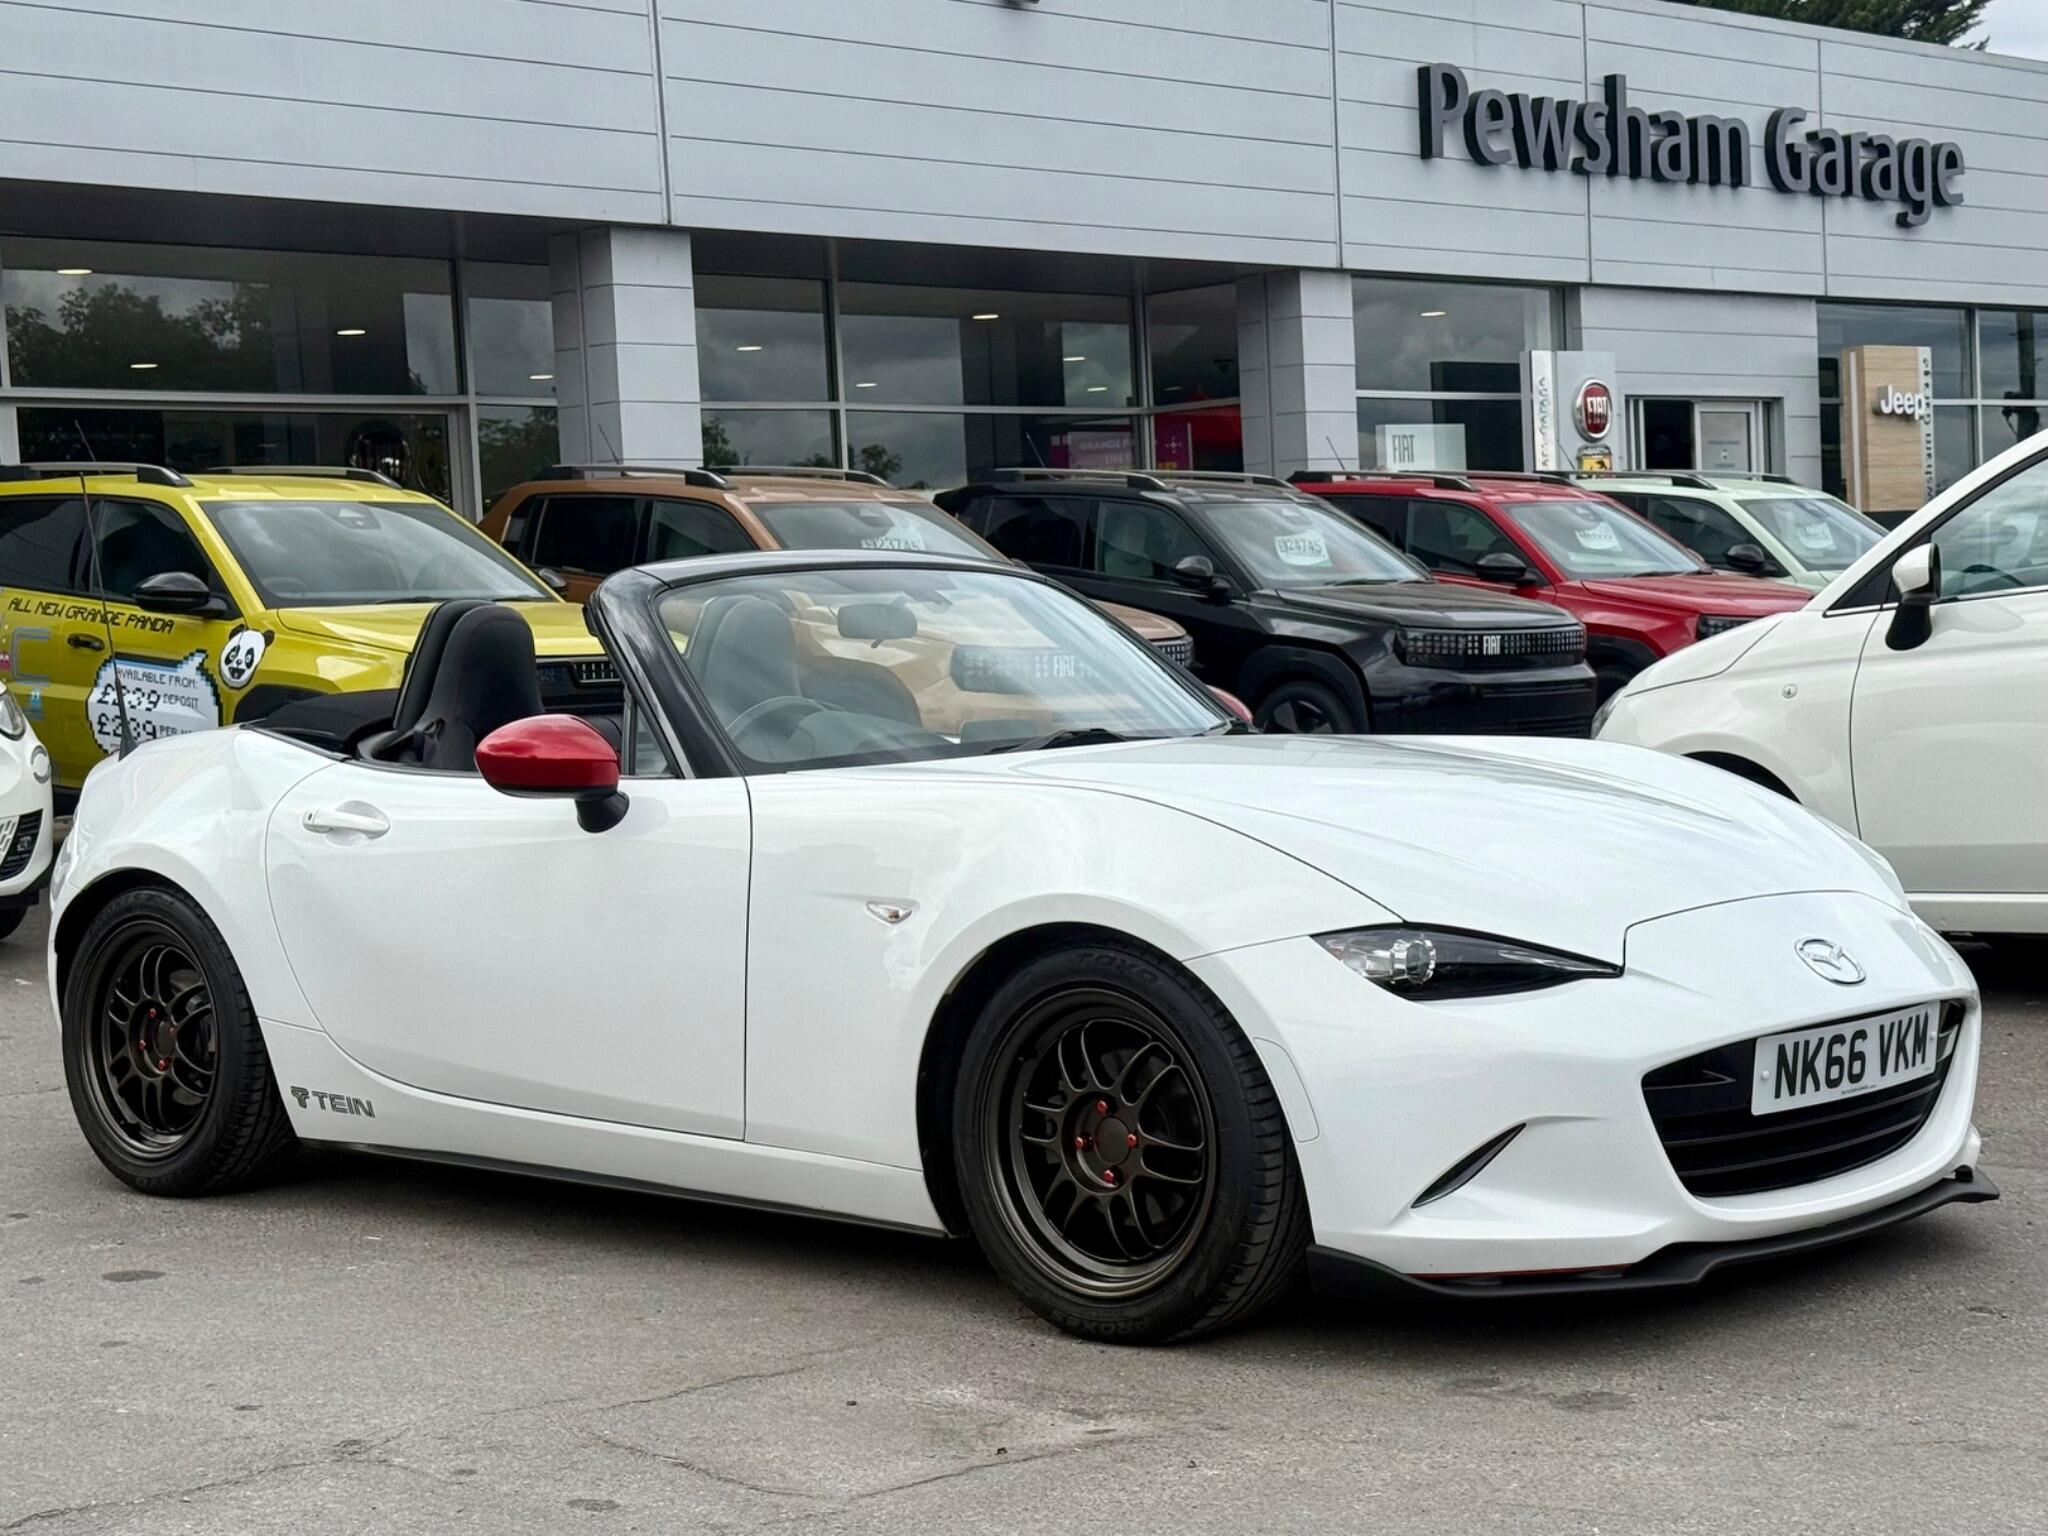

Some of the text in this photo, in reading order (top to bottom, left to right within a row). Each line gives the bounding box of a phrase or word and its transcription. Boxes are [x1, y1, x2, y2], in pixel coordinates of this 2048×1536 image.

[1418, 63, 1964, 228] Pewsham Garage
[1586, 396, 1609, 424] FIAT
[1880, 385, 1927, 421] Jeep
[1391, 434, 1415, 464] FIAT
[8, 597, 175, 634] ALL NEW GRANDE PANDA
[1482, 635, 1502, 656] FIAT
[117, 667, 198, 689] AVAILABLE FROM:
[1053, 655, 1075, 678] FIAT
[163, 693, 199, 709] DEPOSIT
[1774, 1011, 1930, 1099] NK66 VKM
[311, 1090, 376, 1118] TEIN
